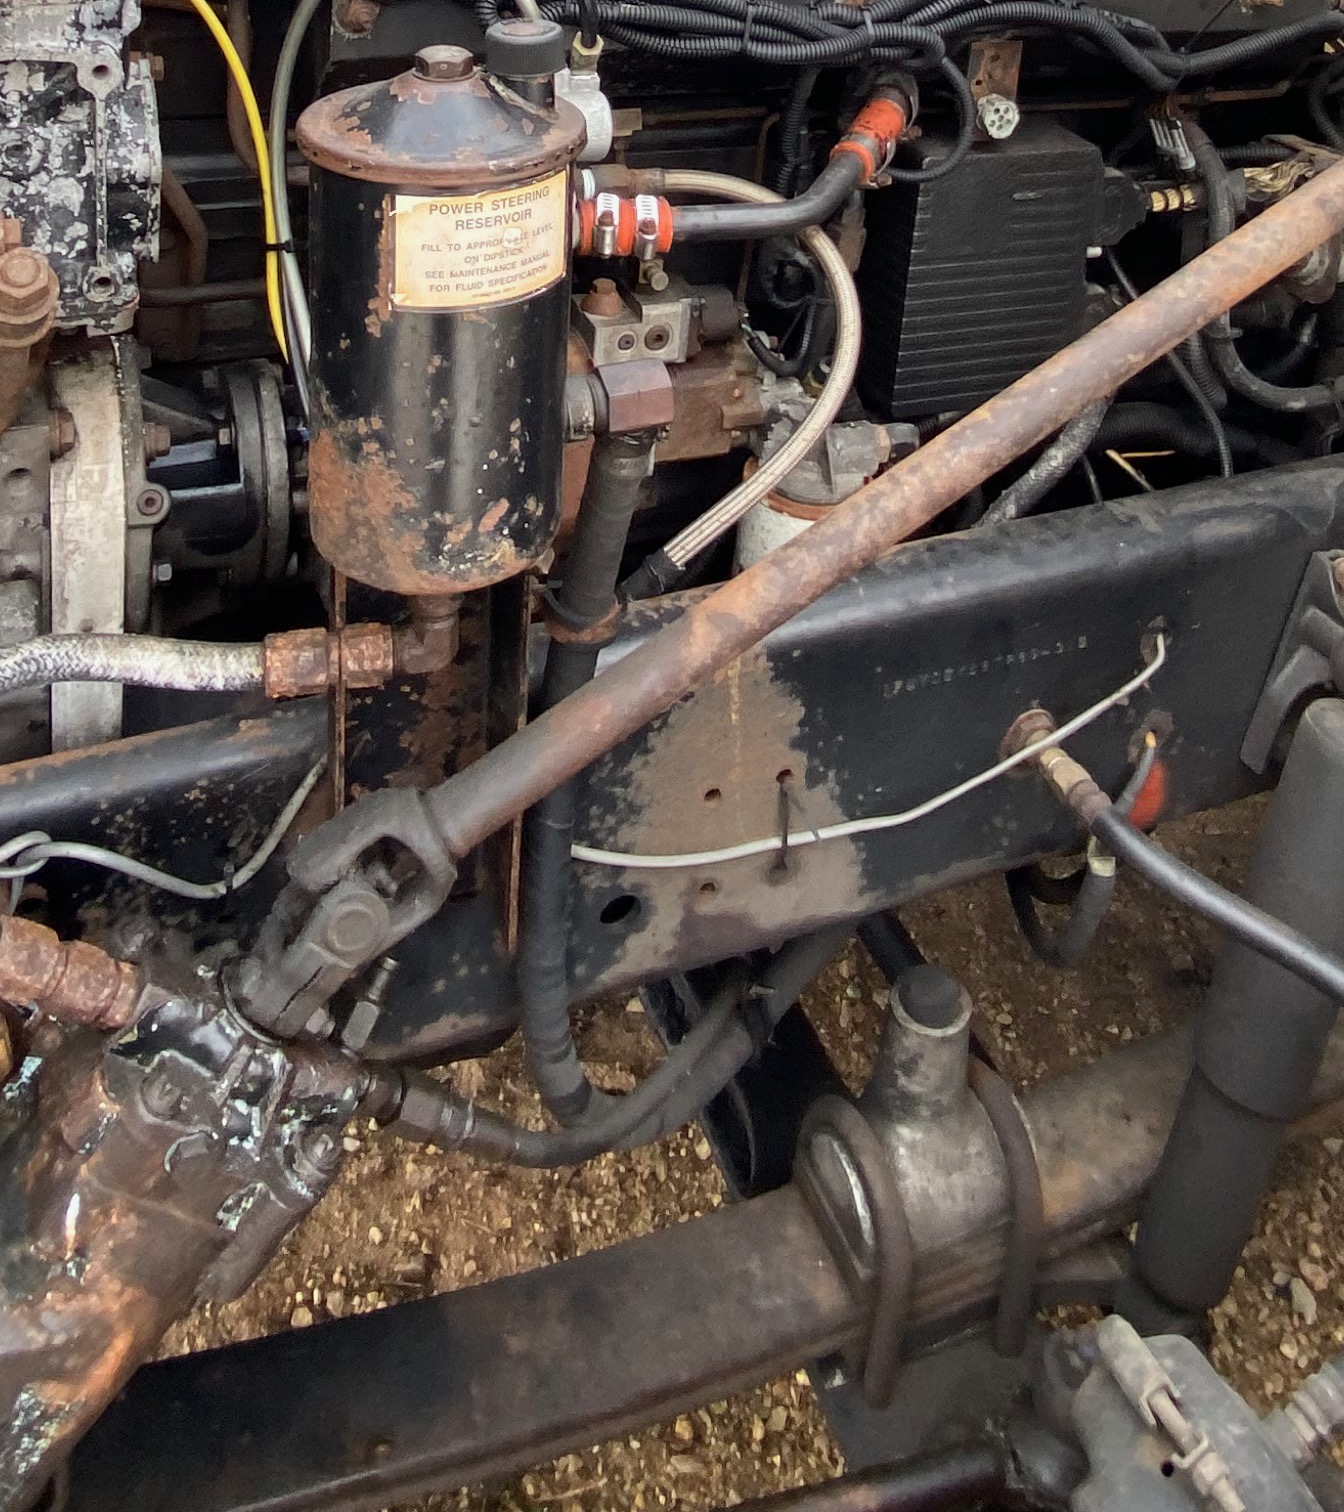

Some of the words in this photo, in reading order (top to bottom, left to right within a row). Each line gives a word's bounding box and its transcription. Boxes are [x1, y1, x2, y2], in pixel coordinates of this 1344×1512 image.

[428, 201, 484, 216] POWER
[490, 185, 550, 211] STEERING
[454, 208, 533, 231] RESERVOIR
[420, 243, 442, 252] FILL
[447, 242, 461, 252] TO
[532, 222, 553, 236] LEVEL
[424, 270, 445, 279] SEE
[449, 260, 517, 279] MAINTENANCE
[520, 250, 550, 267] MANUAL
[464, 254, 479, 264] ON
[429, 283, 450, 293] FOR
[455, 281, 484, 293] FLUID
[488, 263, 547, 288] SPECIFICATION
